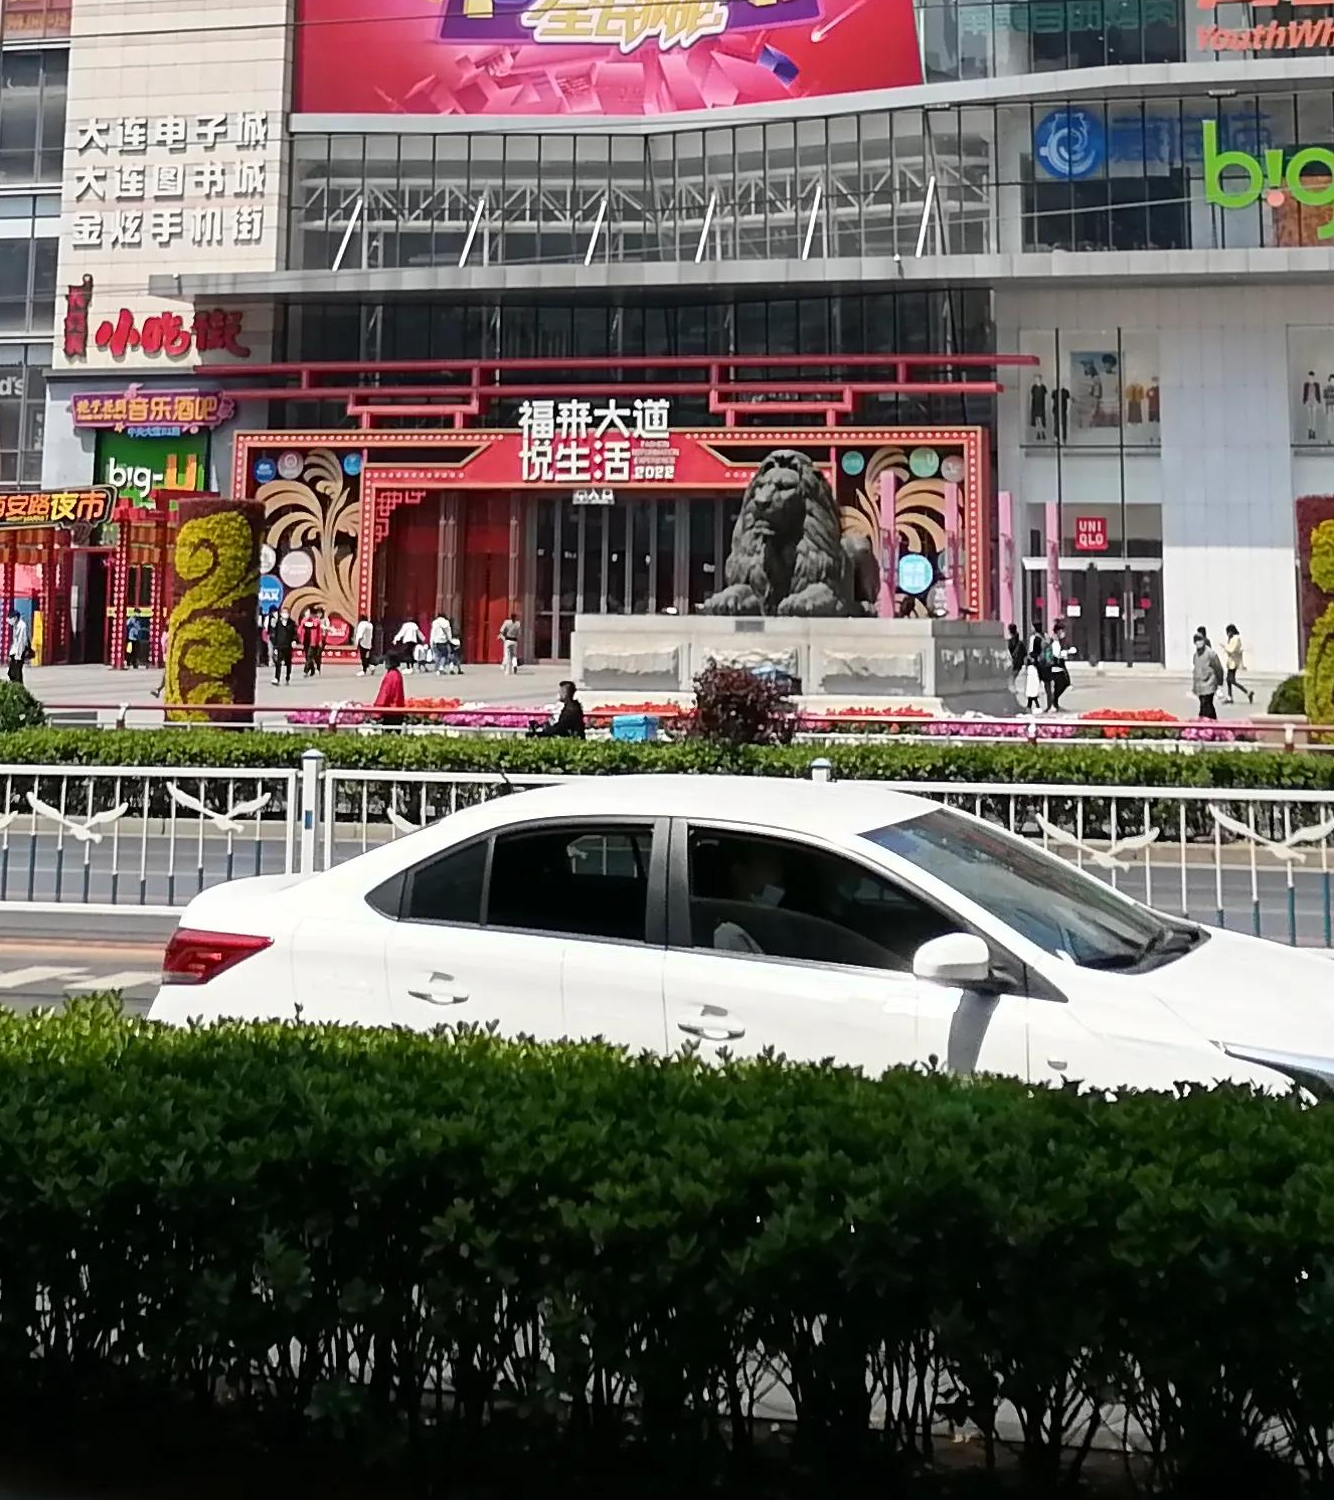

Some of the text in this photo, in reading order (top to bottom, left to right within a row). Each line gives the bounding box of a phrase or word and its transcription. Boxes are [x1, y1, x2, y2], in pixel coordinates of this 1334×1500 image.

[77, 111, 268, 153] 大连电子城
[75, 160, 267, 201] 大连图书城
[518, 399, 670, 439] 福来大道
[518, 439, 631, 481] 悦生活
[634, 465, 675, 480] 2022
[1079, 520, 1102, 532] UNI
[1079, 533, 1104, 548] QLO
